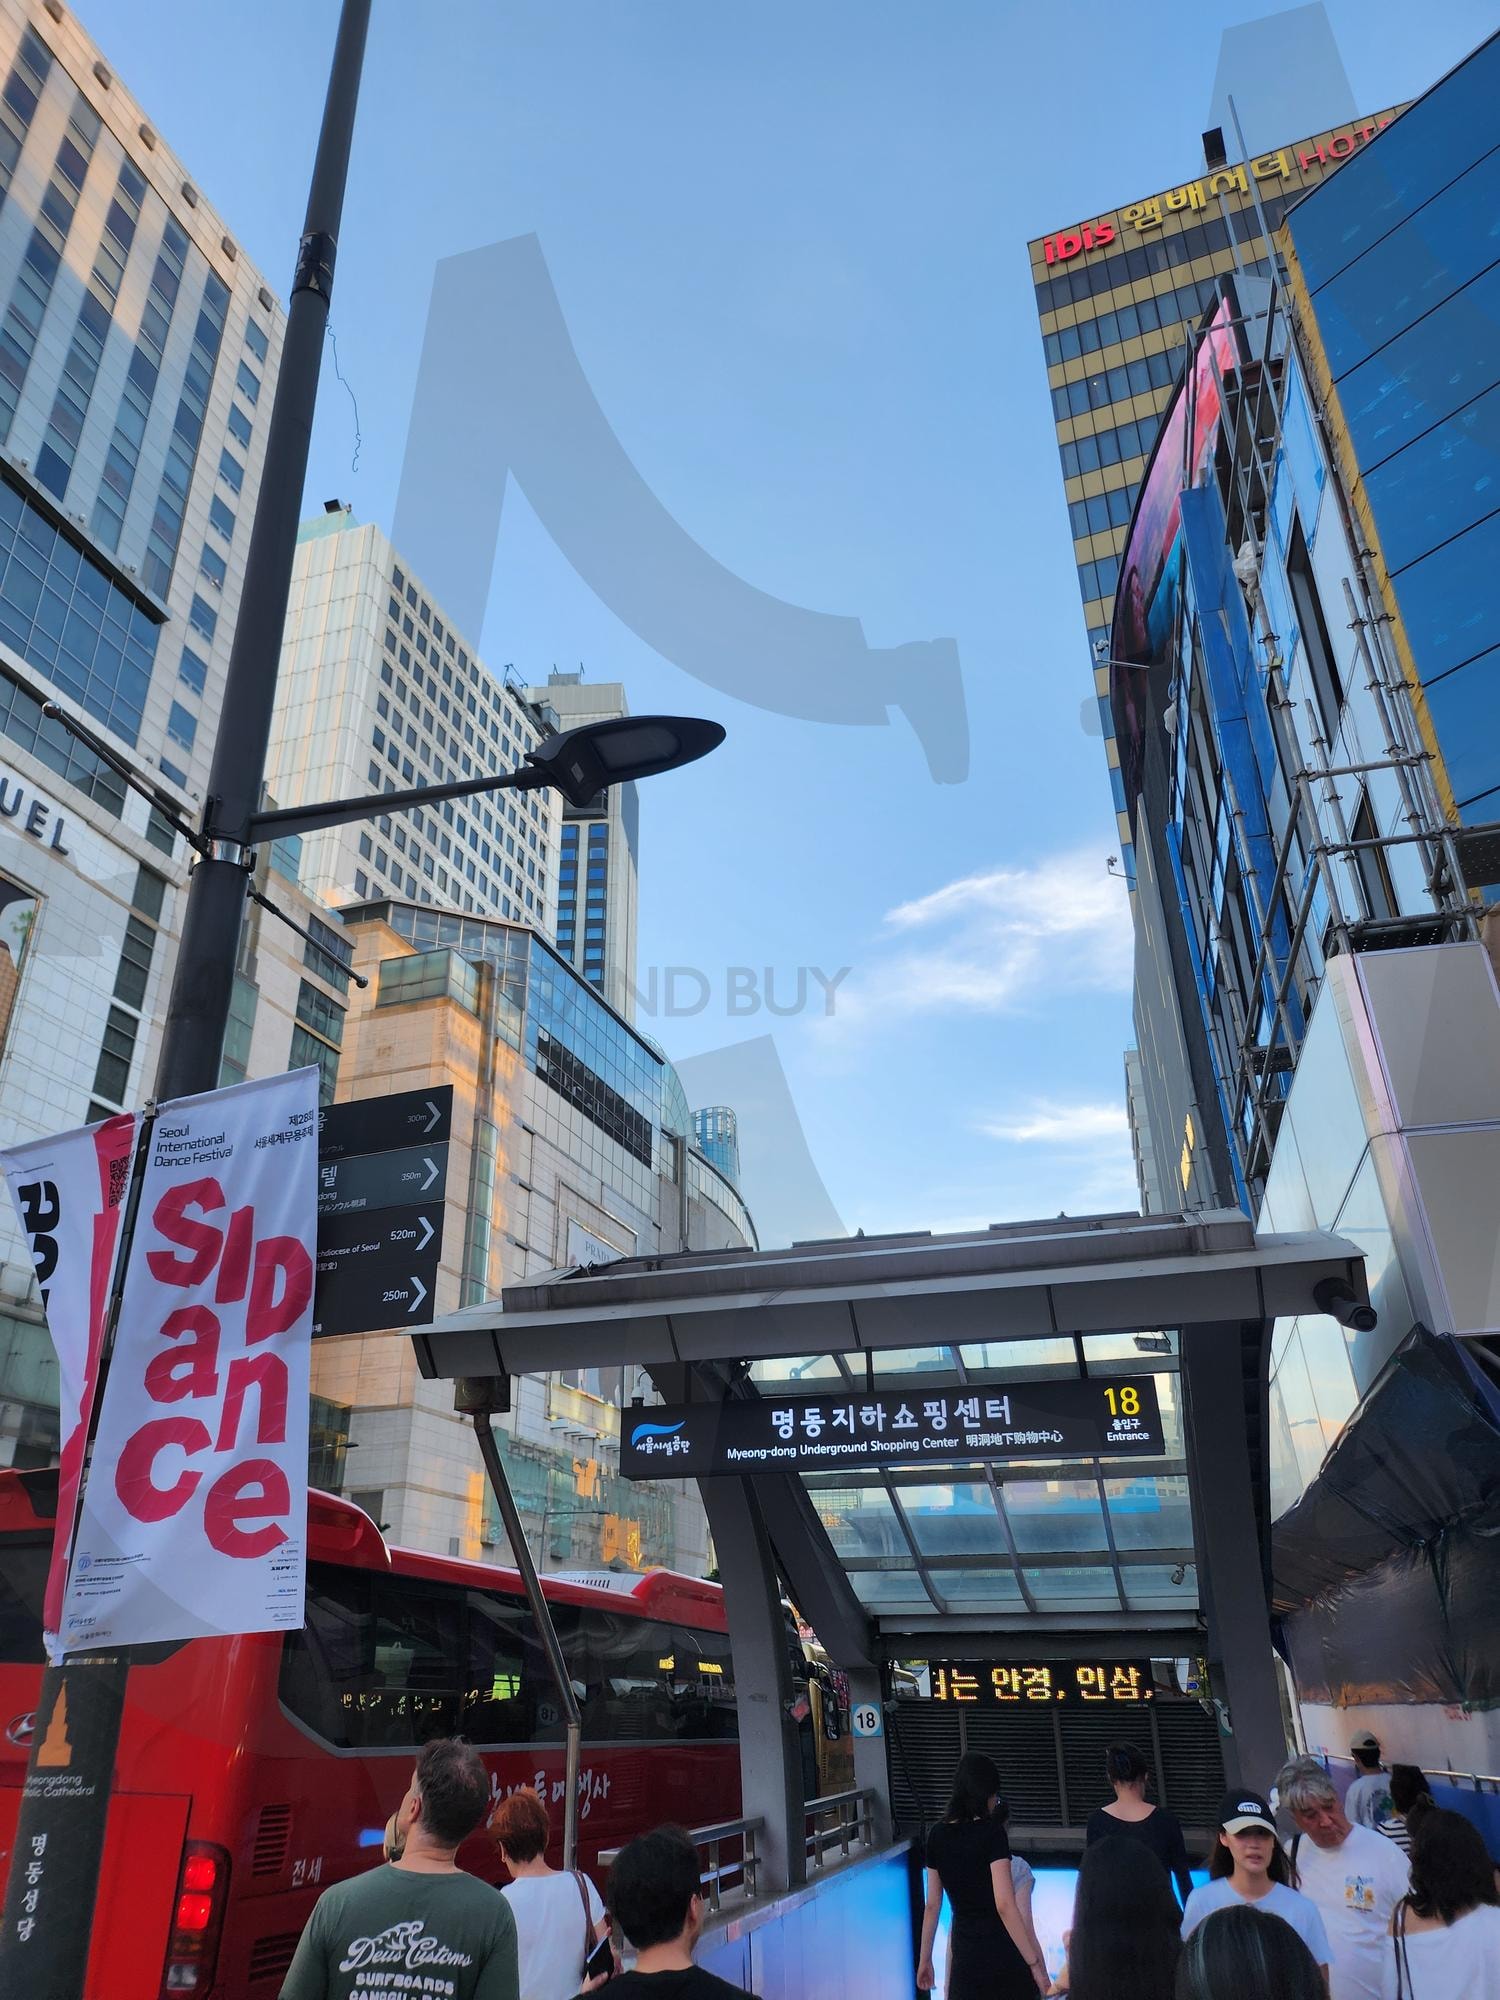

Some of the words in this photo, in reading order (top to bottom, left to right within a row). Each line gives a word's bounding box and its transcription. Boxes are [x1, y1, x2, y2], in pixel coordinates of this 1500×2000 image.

[1043, 221, 1116, 265] ibis
[407, 1114, 428, 1124] 300m
[159, 1124, 190, 1138] Seoul
[156, 1132, 226, 1153] International
[154, 1155, 191, 1168] Dance
[193, 1145, 234, 1164] Festival
[321, 1165, 338, 1188] 텔
[401, 1172, 422, 1182] 350m
[390, 1229, 417, 1241] 520m
[351, 1244, 361, 1253] of
[361, 1241, 381, 1252] Seoul
[382, 1289, 409, 1302] 250m
[1103, 1386, 1141, 1417] 18
[771, 1396, 1011, 1440] 명동지하쇼핑센터
[1111, 1418, 1141, 1431] 출입구
[636, 1435, 691, 1457] 서울시설공단
[727, 1445, 797, 1461] Myeong-dong
[800, 1441, 868, 1456] Underground
[870, 1438, 920, 1453] Shopping
[922, 1436, 959, 1449] Center
[965, 1430, 1064, 1447] 明洞地下购物中心
[1106, 1431, 1150, 1442] Entrance
[856, 1711, 876, 1729] 18
[43, 1785, 96, 1798] Cathedral
[291, 1856, 323, 1887] 전세
[16, 1832, 48, 1942] 명동성당
[338, 1936, 403, 1973] Deus
[404, 1936, 473, 1970] Customs
[355, 1971, 455, 1995] SURFBOARDS
